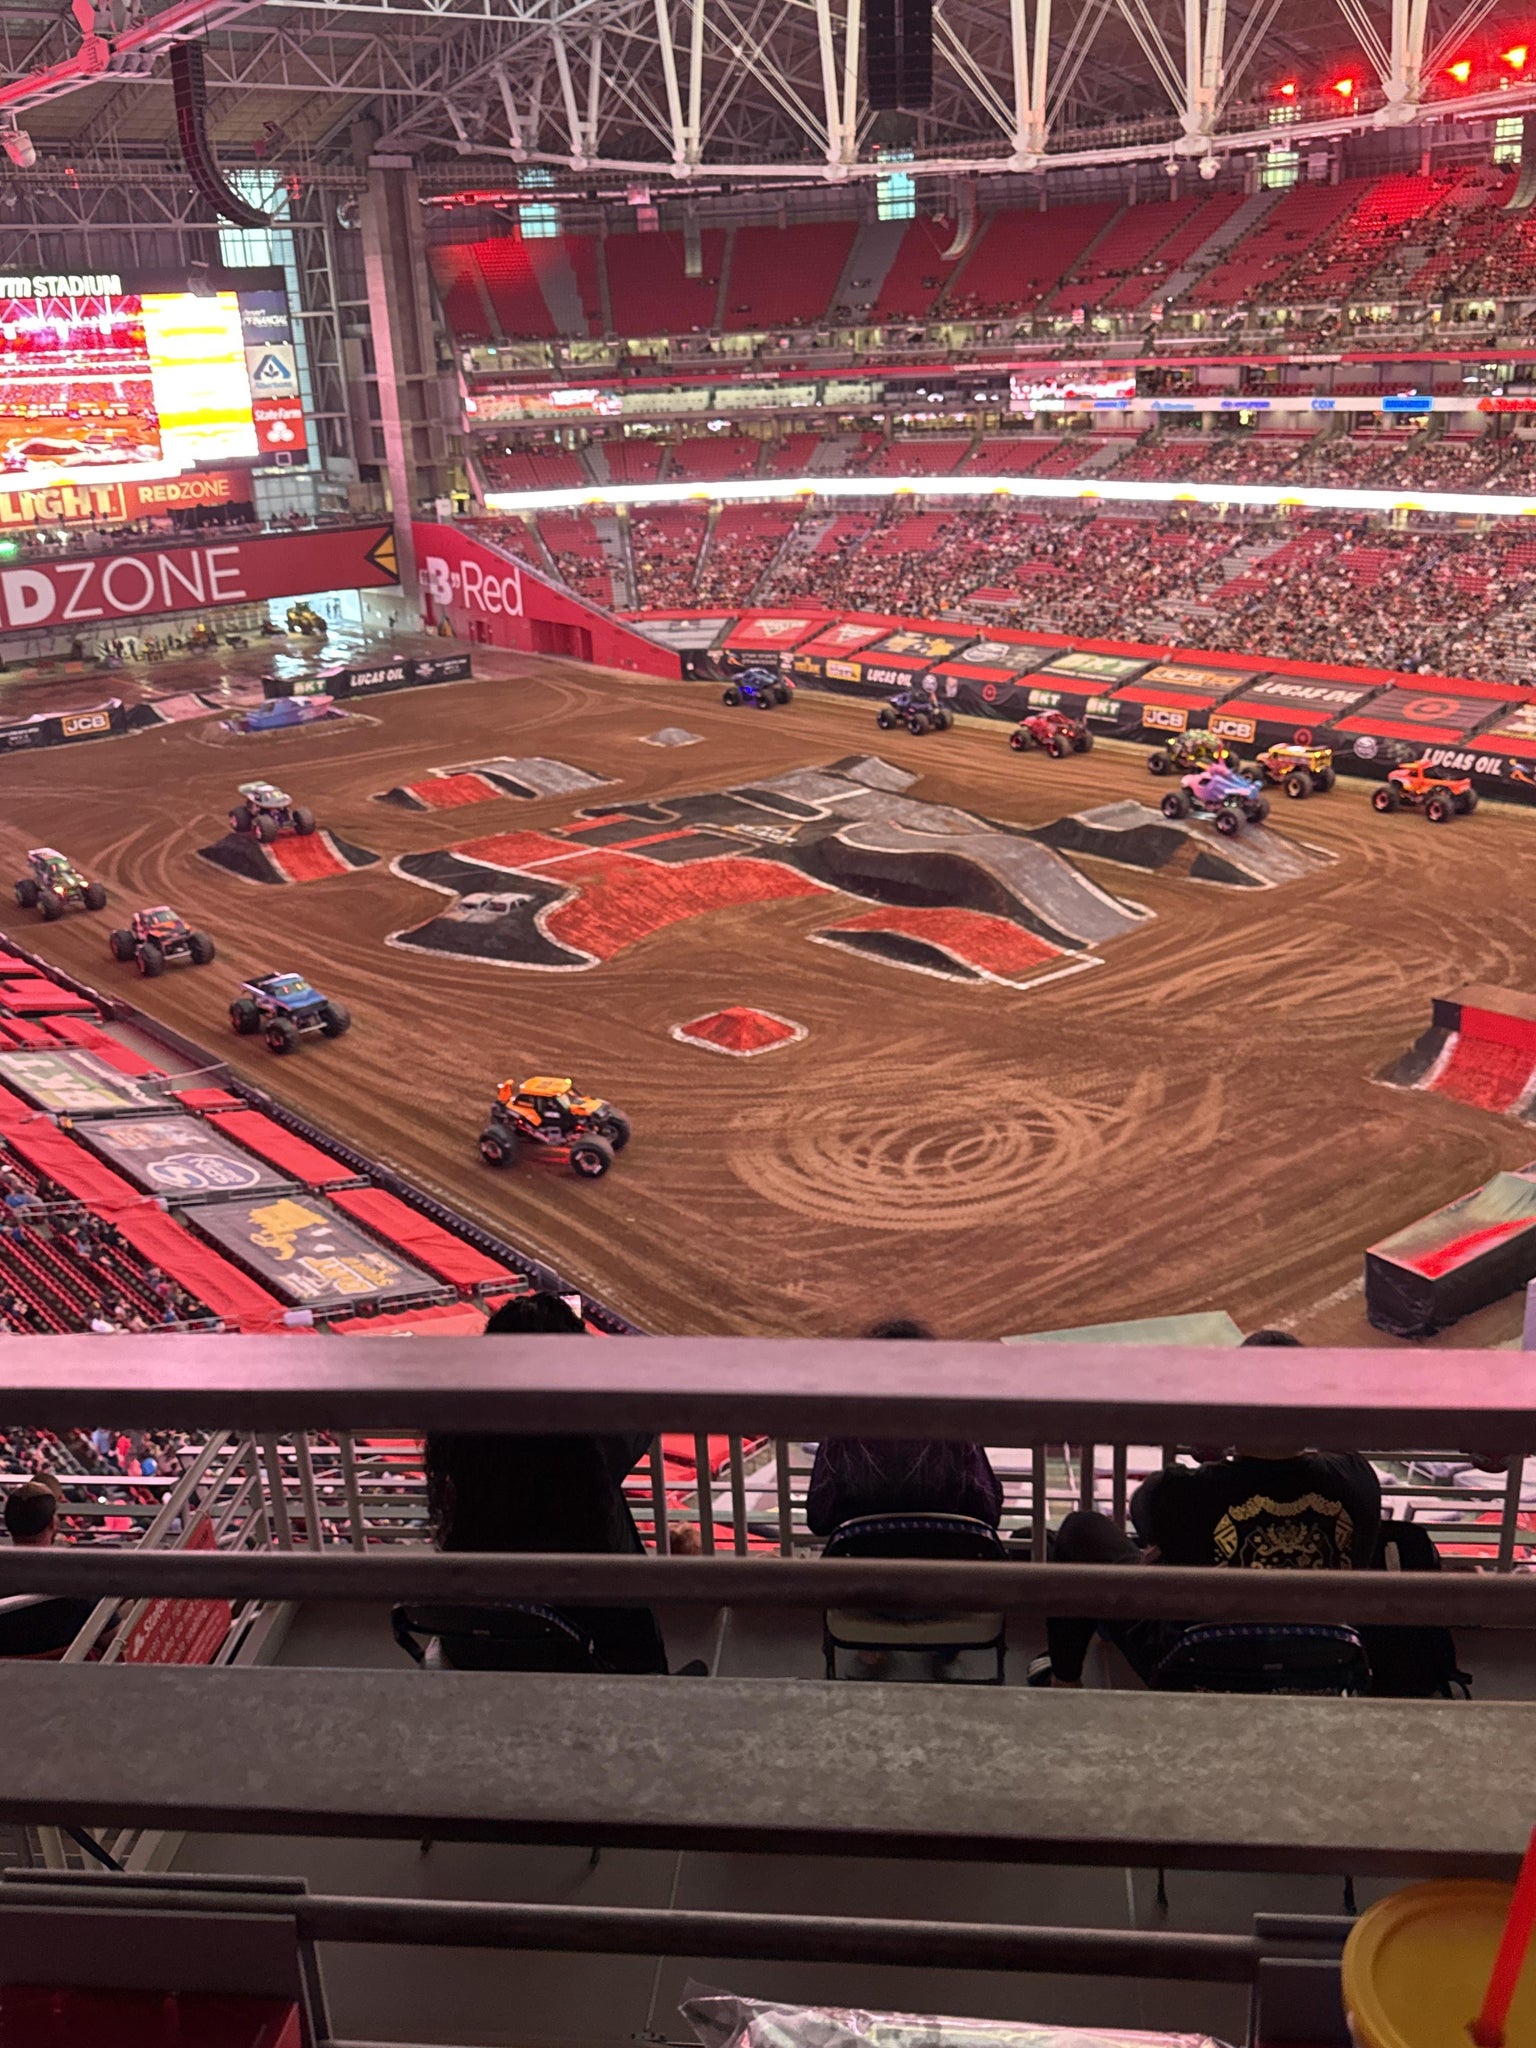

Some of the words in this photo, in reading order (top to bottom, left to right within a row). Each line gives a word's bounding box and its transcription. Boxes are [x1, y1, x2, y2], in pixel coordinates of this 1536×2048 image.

[33, 275, 122, 297] STADIUM
[1311, 400, 1335, 409] COX
[254, 409, 277, 421] State
[277, 408, 302, 419] Farm
[138, 479, 230, 503] REDZONE
[1, 484, 114, 522] LIGHT
[0, 546, 247, 627] DZONE
[461, 560, 524, 617] Red
[350, 670, 385, 687] LUCAS
[386, 668, 404, 681] OIL
[867, 668, 897, 686] LUCAS
[896, 672, 913, 688] OIL
[1253, 681, 1327, 699] LUCAS
[66, 715, 106, 732] JCB
[1146, 710, 1184, 727] JCB
[1212, 720, 1251, 737] JCB
[1422, 748, 1476, 771] LUCAS
[1475, 756, 1503, 776] OIL
